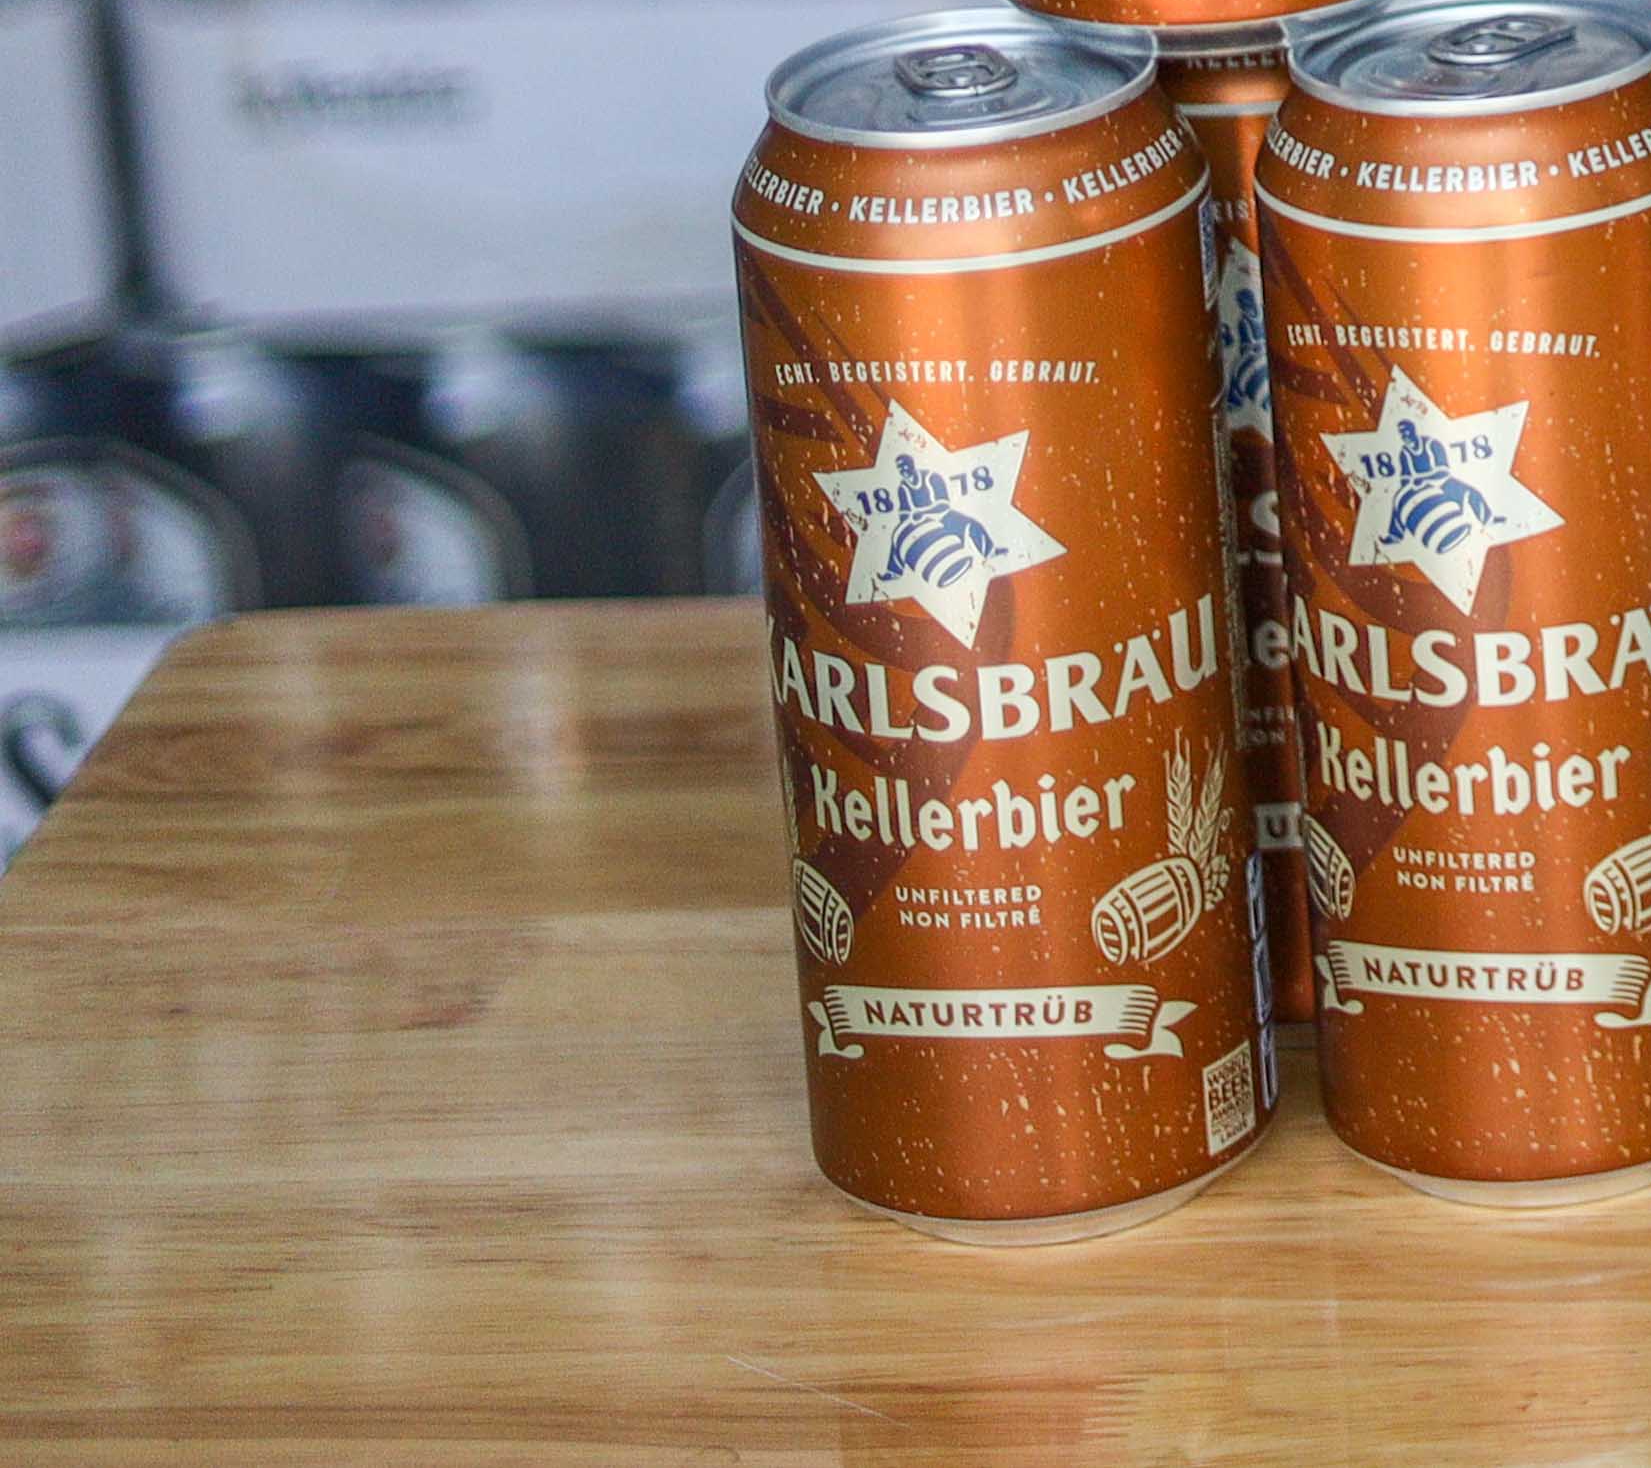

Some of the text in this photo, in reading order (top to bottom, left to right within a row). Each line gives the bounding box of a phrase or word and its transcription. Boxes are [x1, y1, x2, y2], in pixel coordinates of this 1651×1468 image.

[1356, 159, 1538, 194] KELLERBIER
[849, 190, 1035, 223] KELLERBIER
[775, 360, 1100, 386] ECHT. BEGEISTERT. GEBRAUT.
[1317, 721, 1630, 817] Kellerbier
[811, 763, 1136, 852] Kellerbier
[1394, 847, 1535, 870] UNFILTERED
[1397, 868, 1534, 893] NON FILTRÉ
[1362, 956, 1584, 991] NATURTRÜB
[863, 995, 1093, 1027] NATURTRÜB
